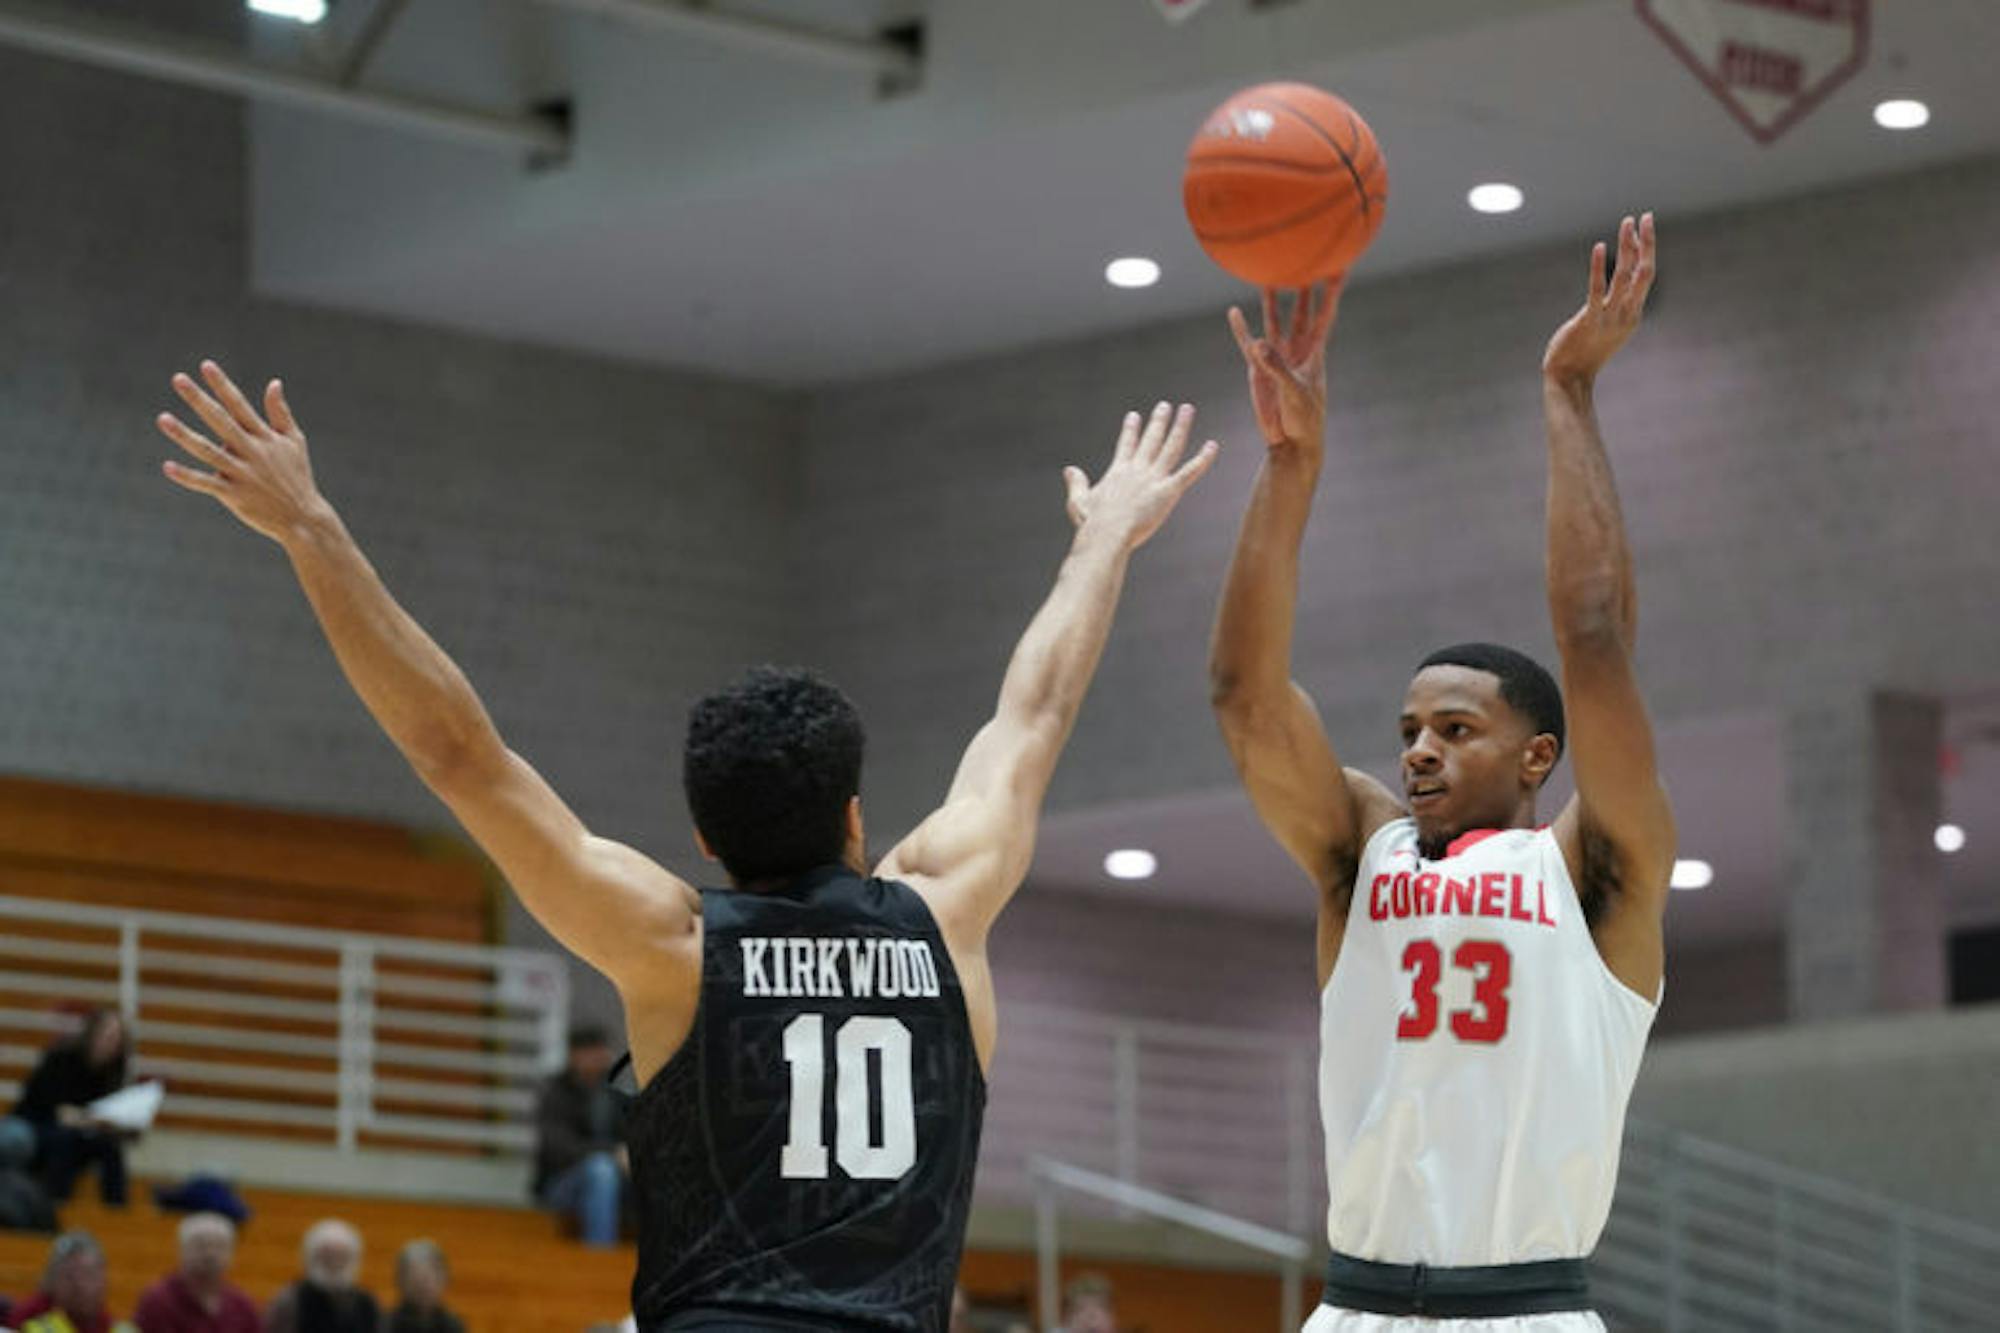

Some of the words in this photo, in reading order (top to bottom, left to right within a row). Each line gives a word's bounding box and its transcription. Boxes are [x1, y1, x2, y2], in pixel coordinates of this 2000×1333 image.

[1369, 871, 1557, 927] CORNELL
[740, 937, 941, 998] KIRKWOOD
[1397, 939, 1512, 1043] 33
[780, 1013, 917, 1180] 10
